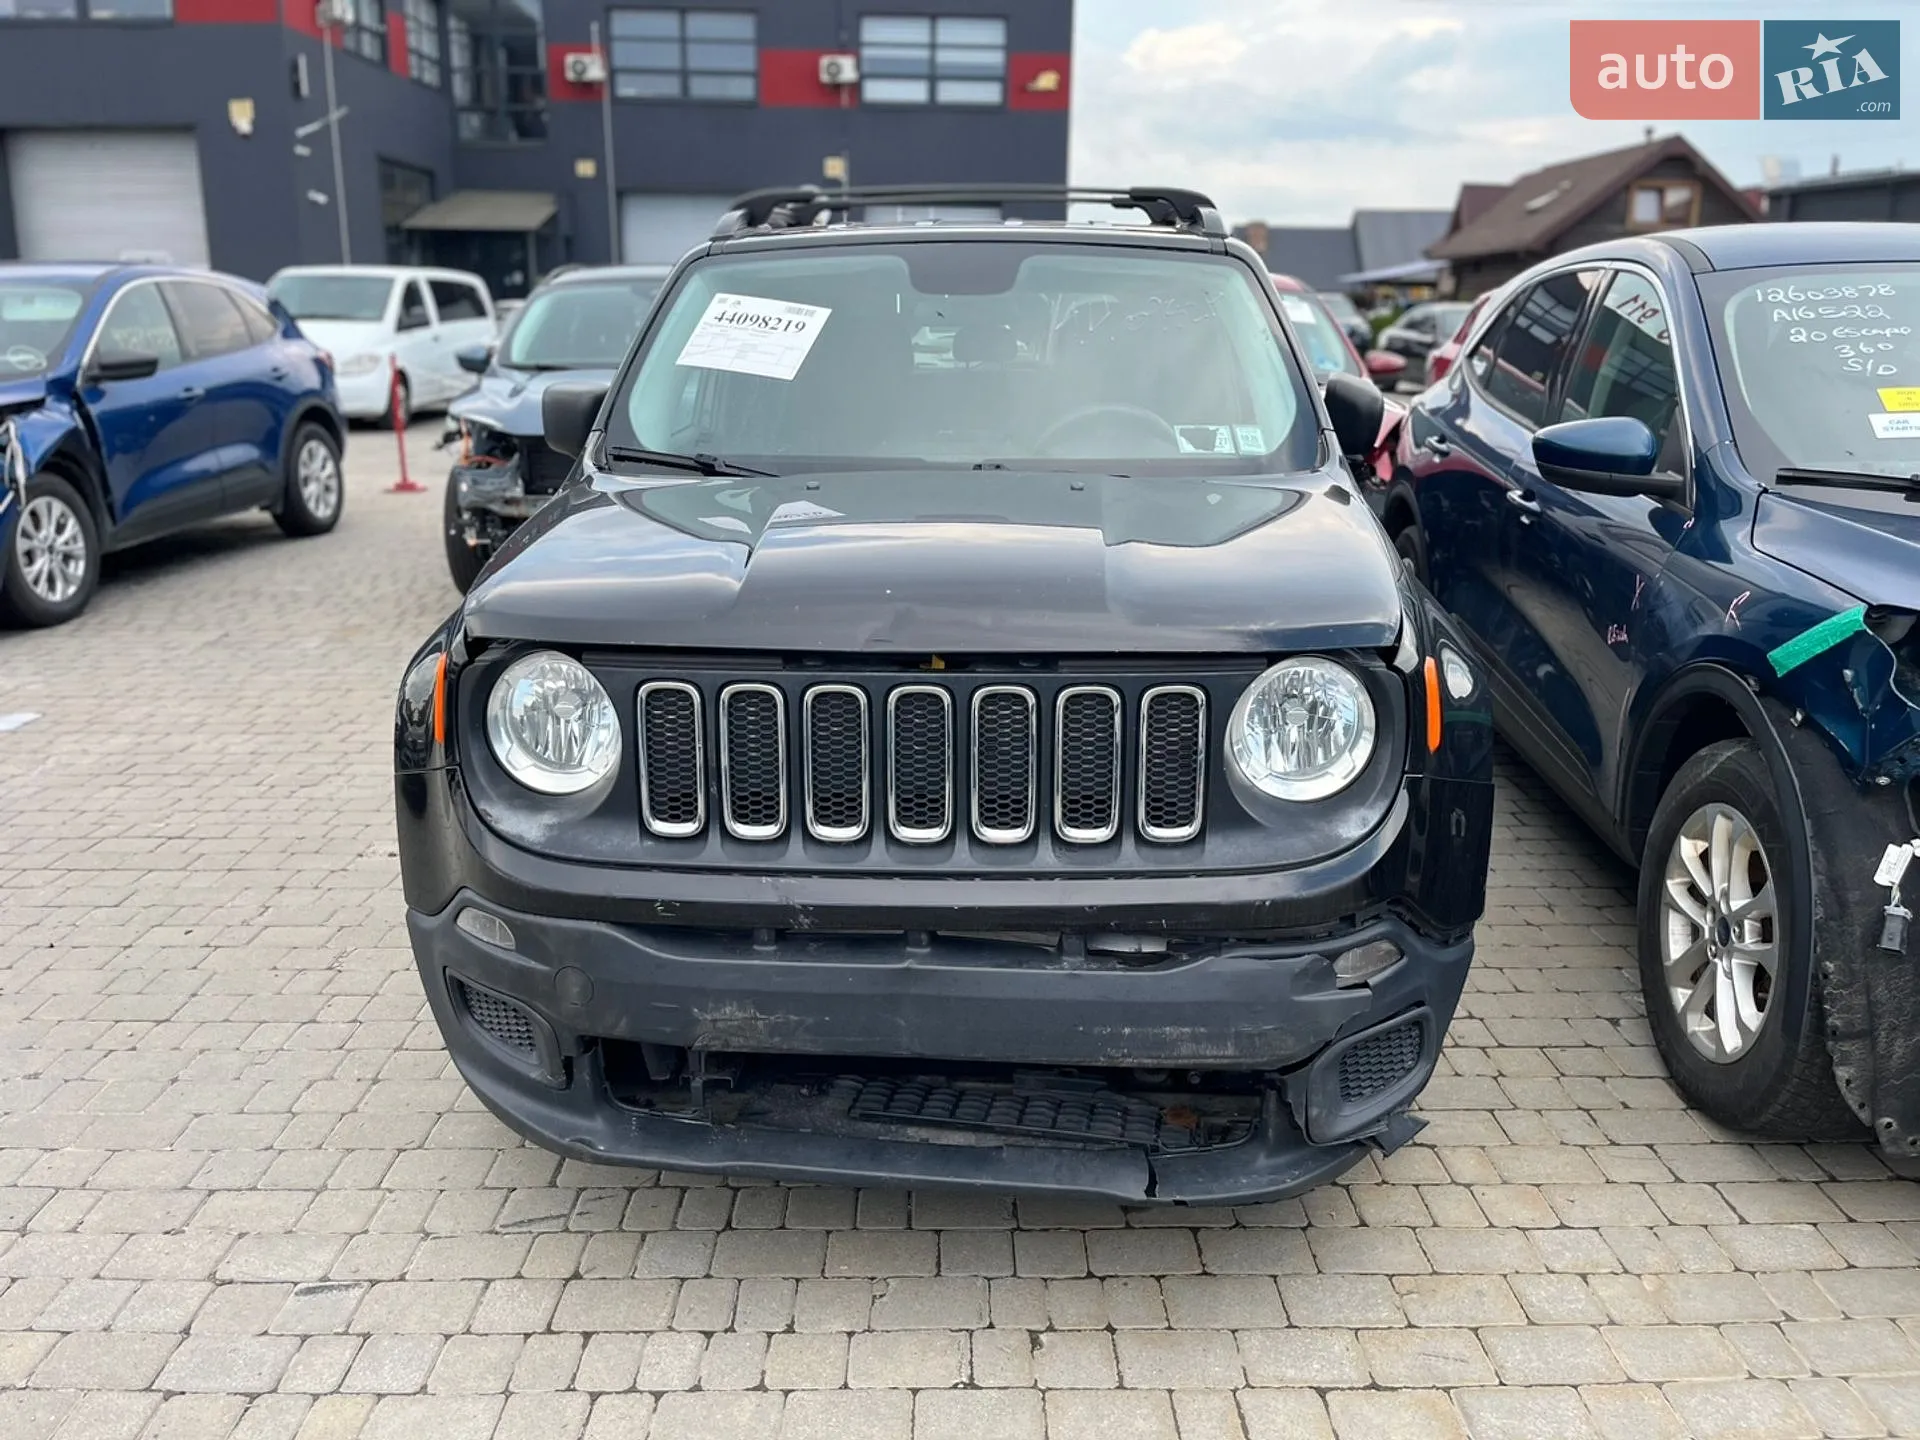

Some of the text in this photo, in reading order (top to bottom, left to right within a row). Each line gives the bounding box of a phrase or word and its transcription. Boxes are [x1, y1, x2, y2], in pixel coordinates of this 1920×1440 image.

[1755, 284, 1896, 303] 12603878
[714, 310, 806, 333] 44098219
[1773, 304, 1891, 322] A16522
[1789, 326, 1828, 343] 20
[1834, 342, 1894, 357] 360
